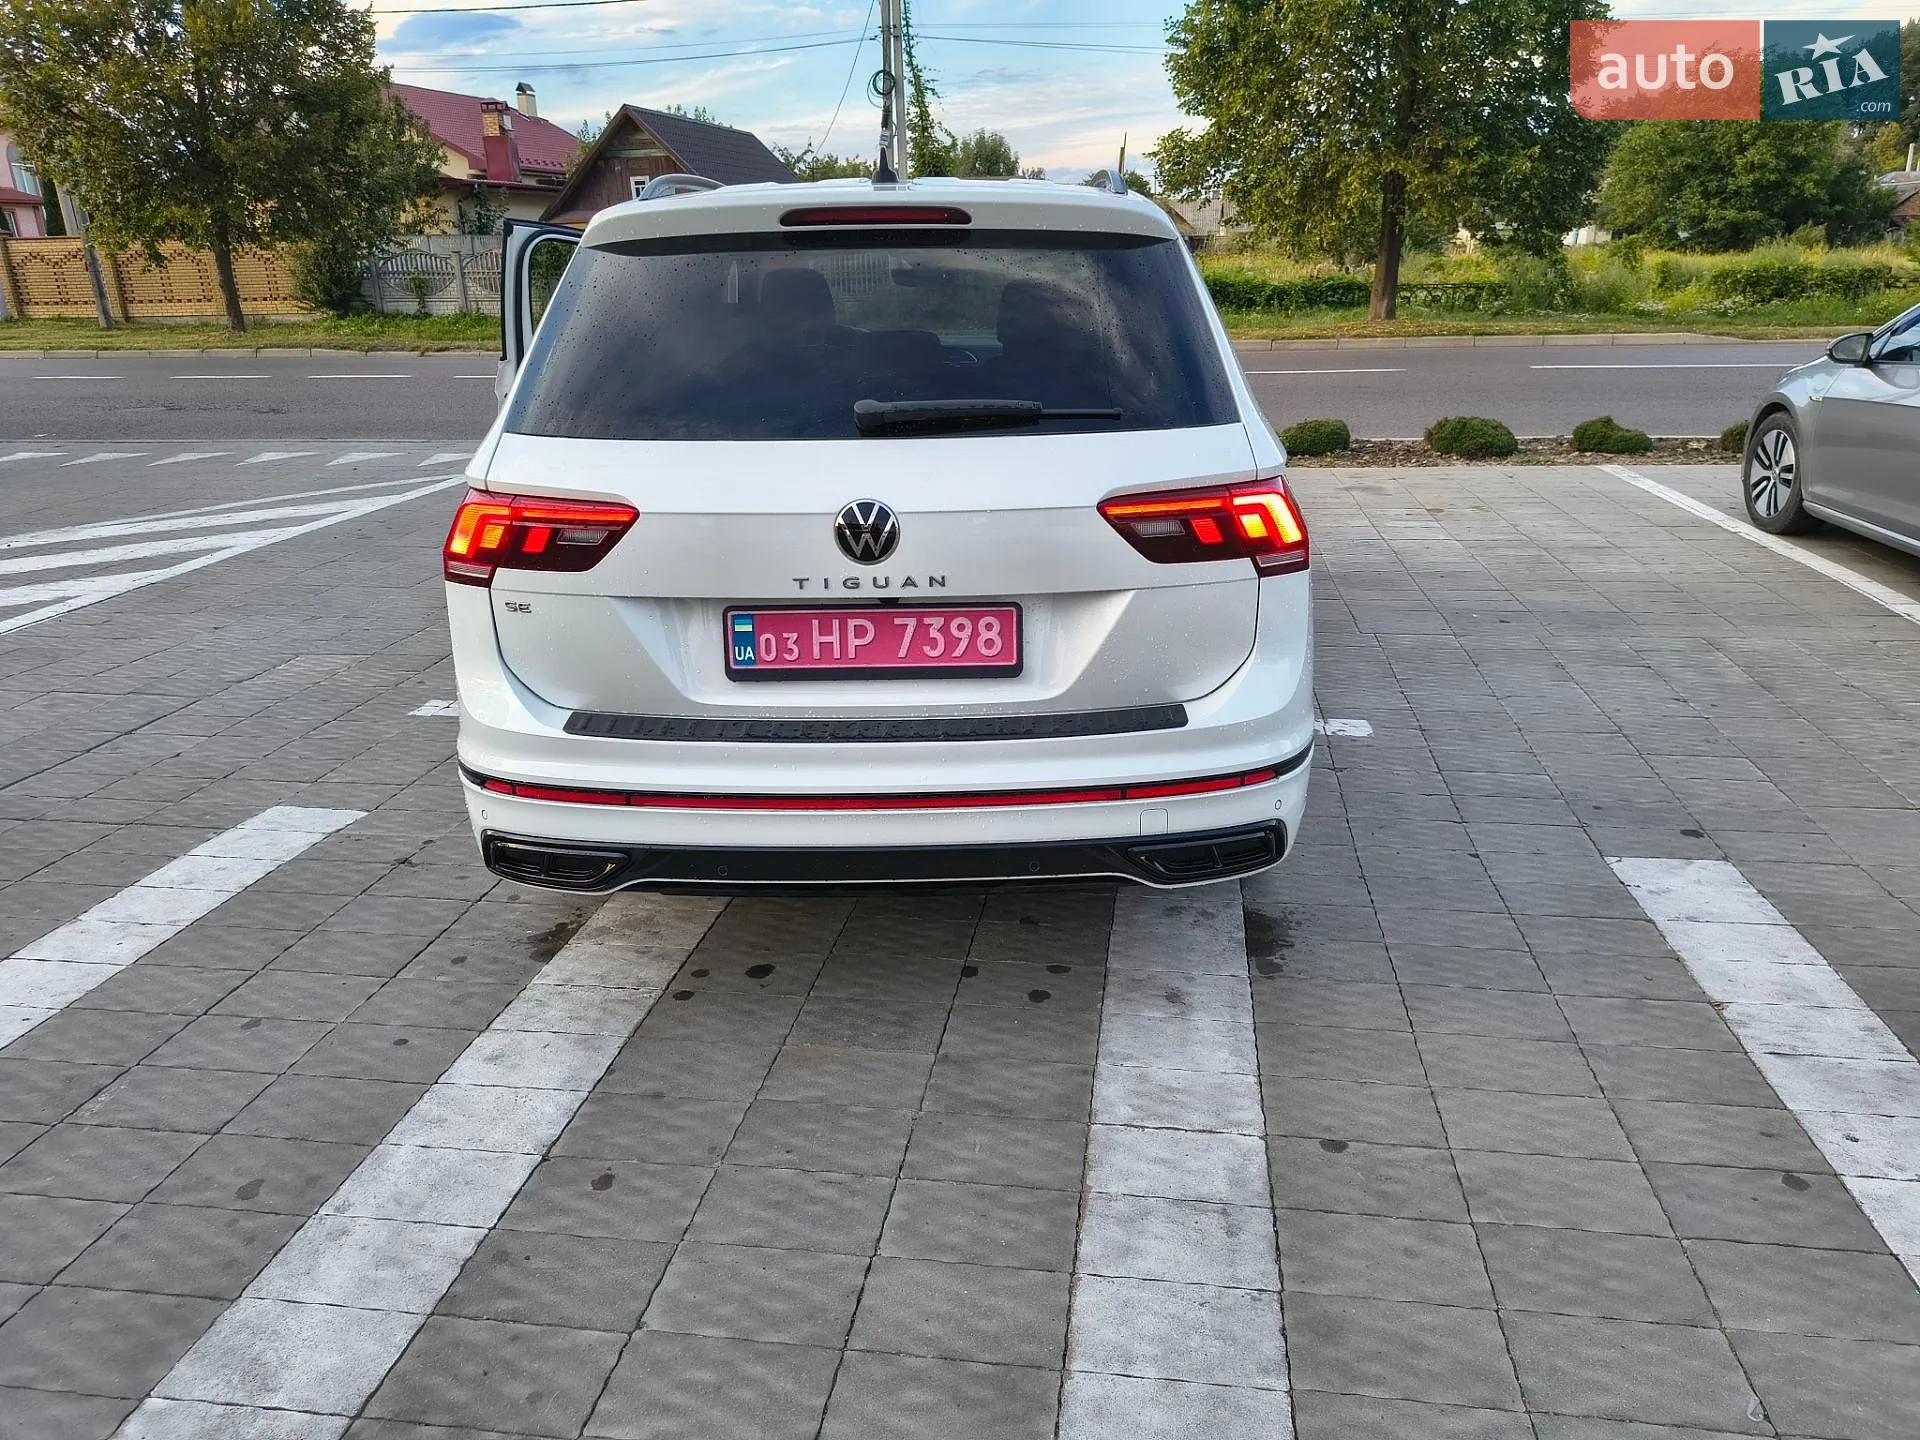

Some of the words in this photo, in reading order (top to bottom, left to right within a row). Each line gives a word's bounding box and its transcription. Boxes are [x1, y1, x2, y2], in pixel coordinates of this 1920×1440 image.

[792, 575, 947, 590] TIGUAN
[504, 601, 532, 613] SE
[759, 632, 800, 662] 03
[812, 618, 876, 660] HP
[893, 616, 1003, 658] 7398
[734, 646, 755, 661] UA
